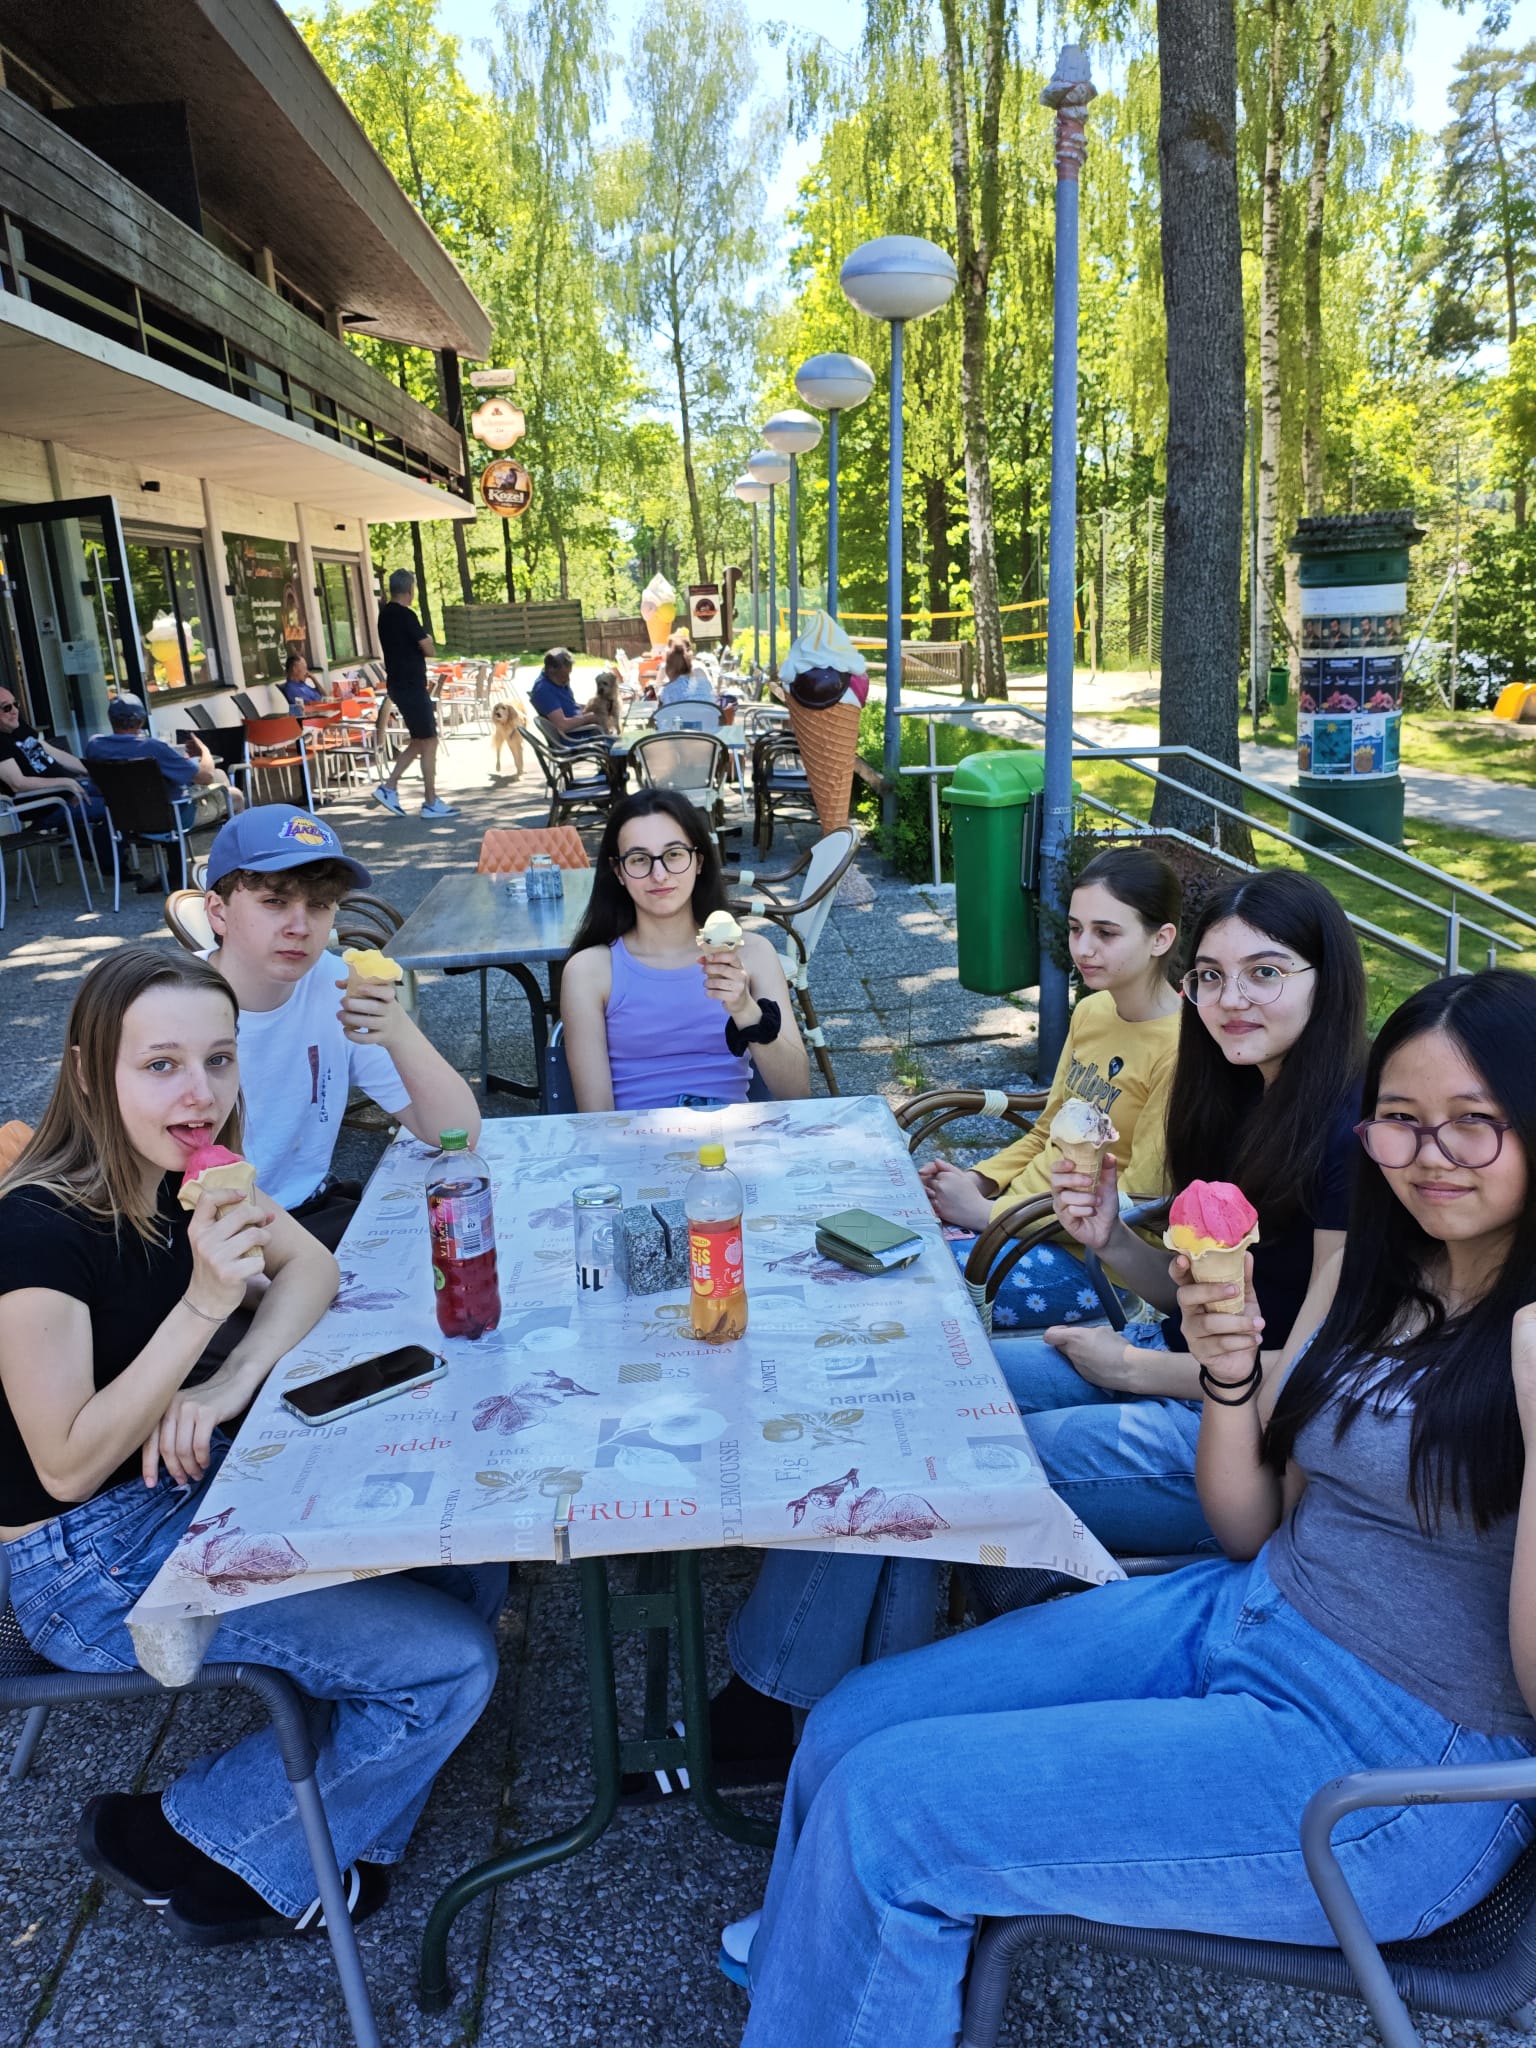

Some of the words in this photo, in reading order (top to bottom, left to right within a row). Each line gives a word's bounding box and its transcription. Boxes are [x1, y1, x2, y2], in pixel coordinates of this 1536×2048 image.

[488, 488, 525, 503] Kozel
[367, 1226, 428, 1237] naranj
[941, 1318, 972, 1368] ORANGE
[655, 1347, 733, 1359] NAVELINA
[760, 1359, 778, 1393] LEMON
[830, 1389, 916, 1406] naranja
[955, 1402, 1017, 1421] pple
[259, 1424, 348, 1441] naranja
[375, 1436, 452, 1457] apple
[775, 1456, 811, 1483] Fig
[567, 1497, 698, 1523] FRUITS
